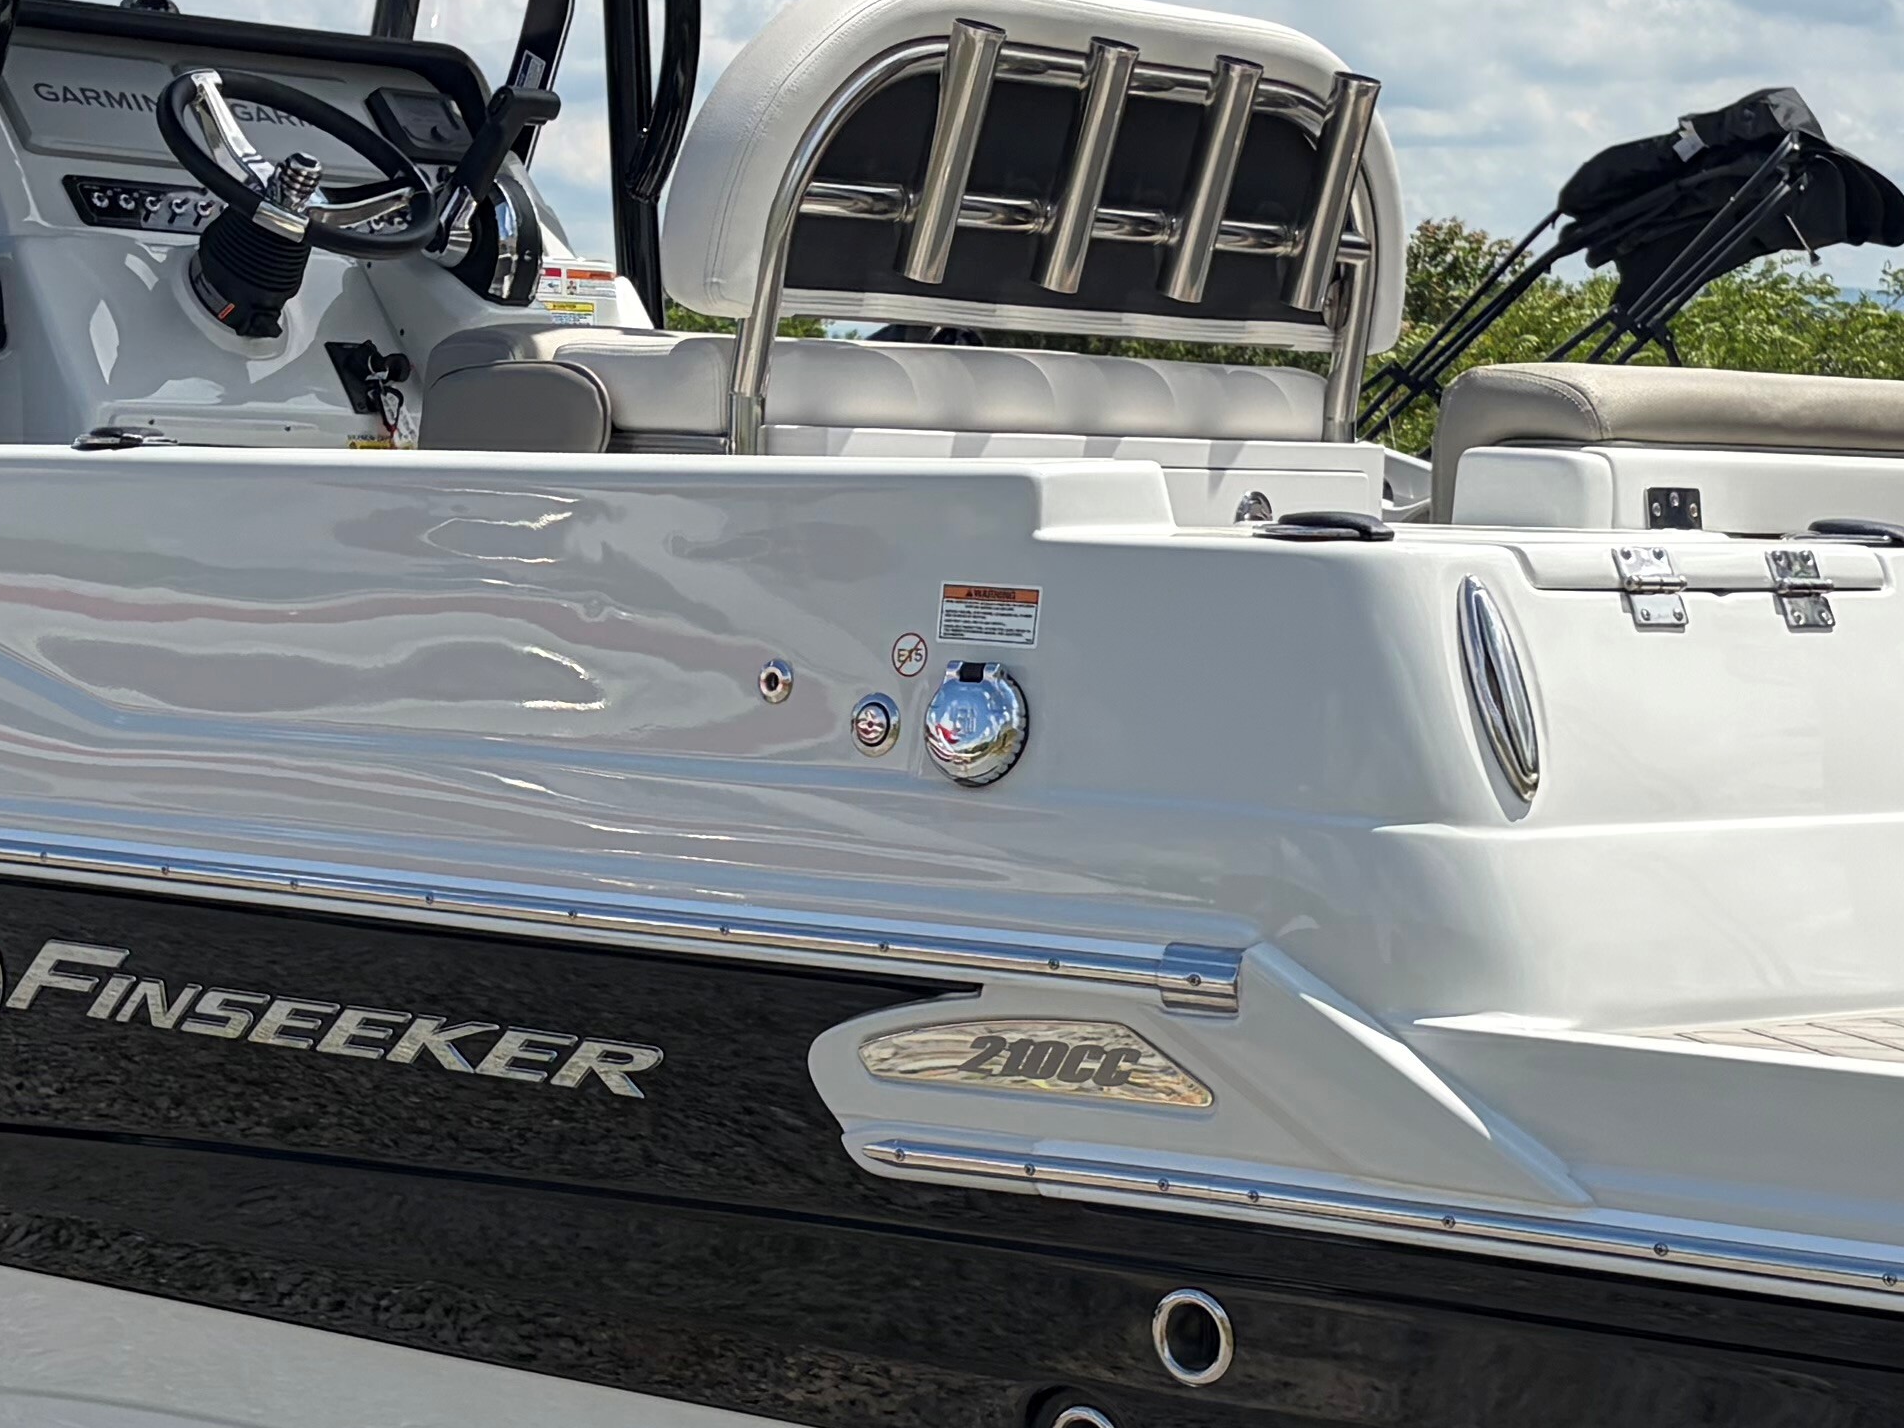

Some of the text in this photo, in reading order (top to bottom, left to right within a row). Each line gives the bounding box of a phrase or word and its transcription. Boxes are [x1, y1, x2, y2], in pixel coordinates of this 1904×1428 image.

[230, 102, 313, 128] GAR
[897, 647, 923, 663] E15
[5, 938, 665, 1099] FINSEEKER
[957, 1034, 1142, 1087] 210CC
